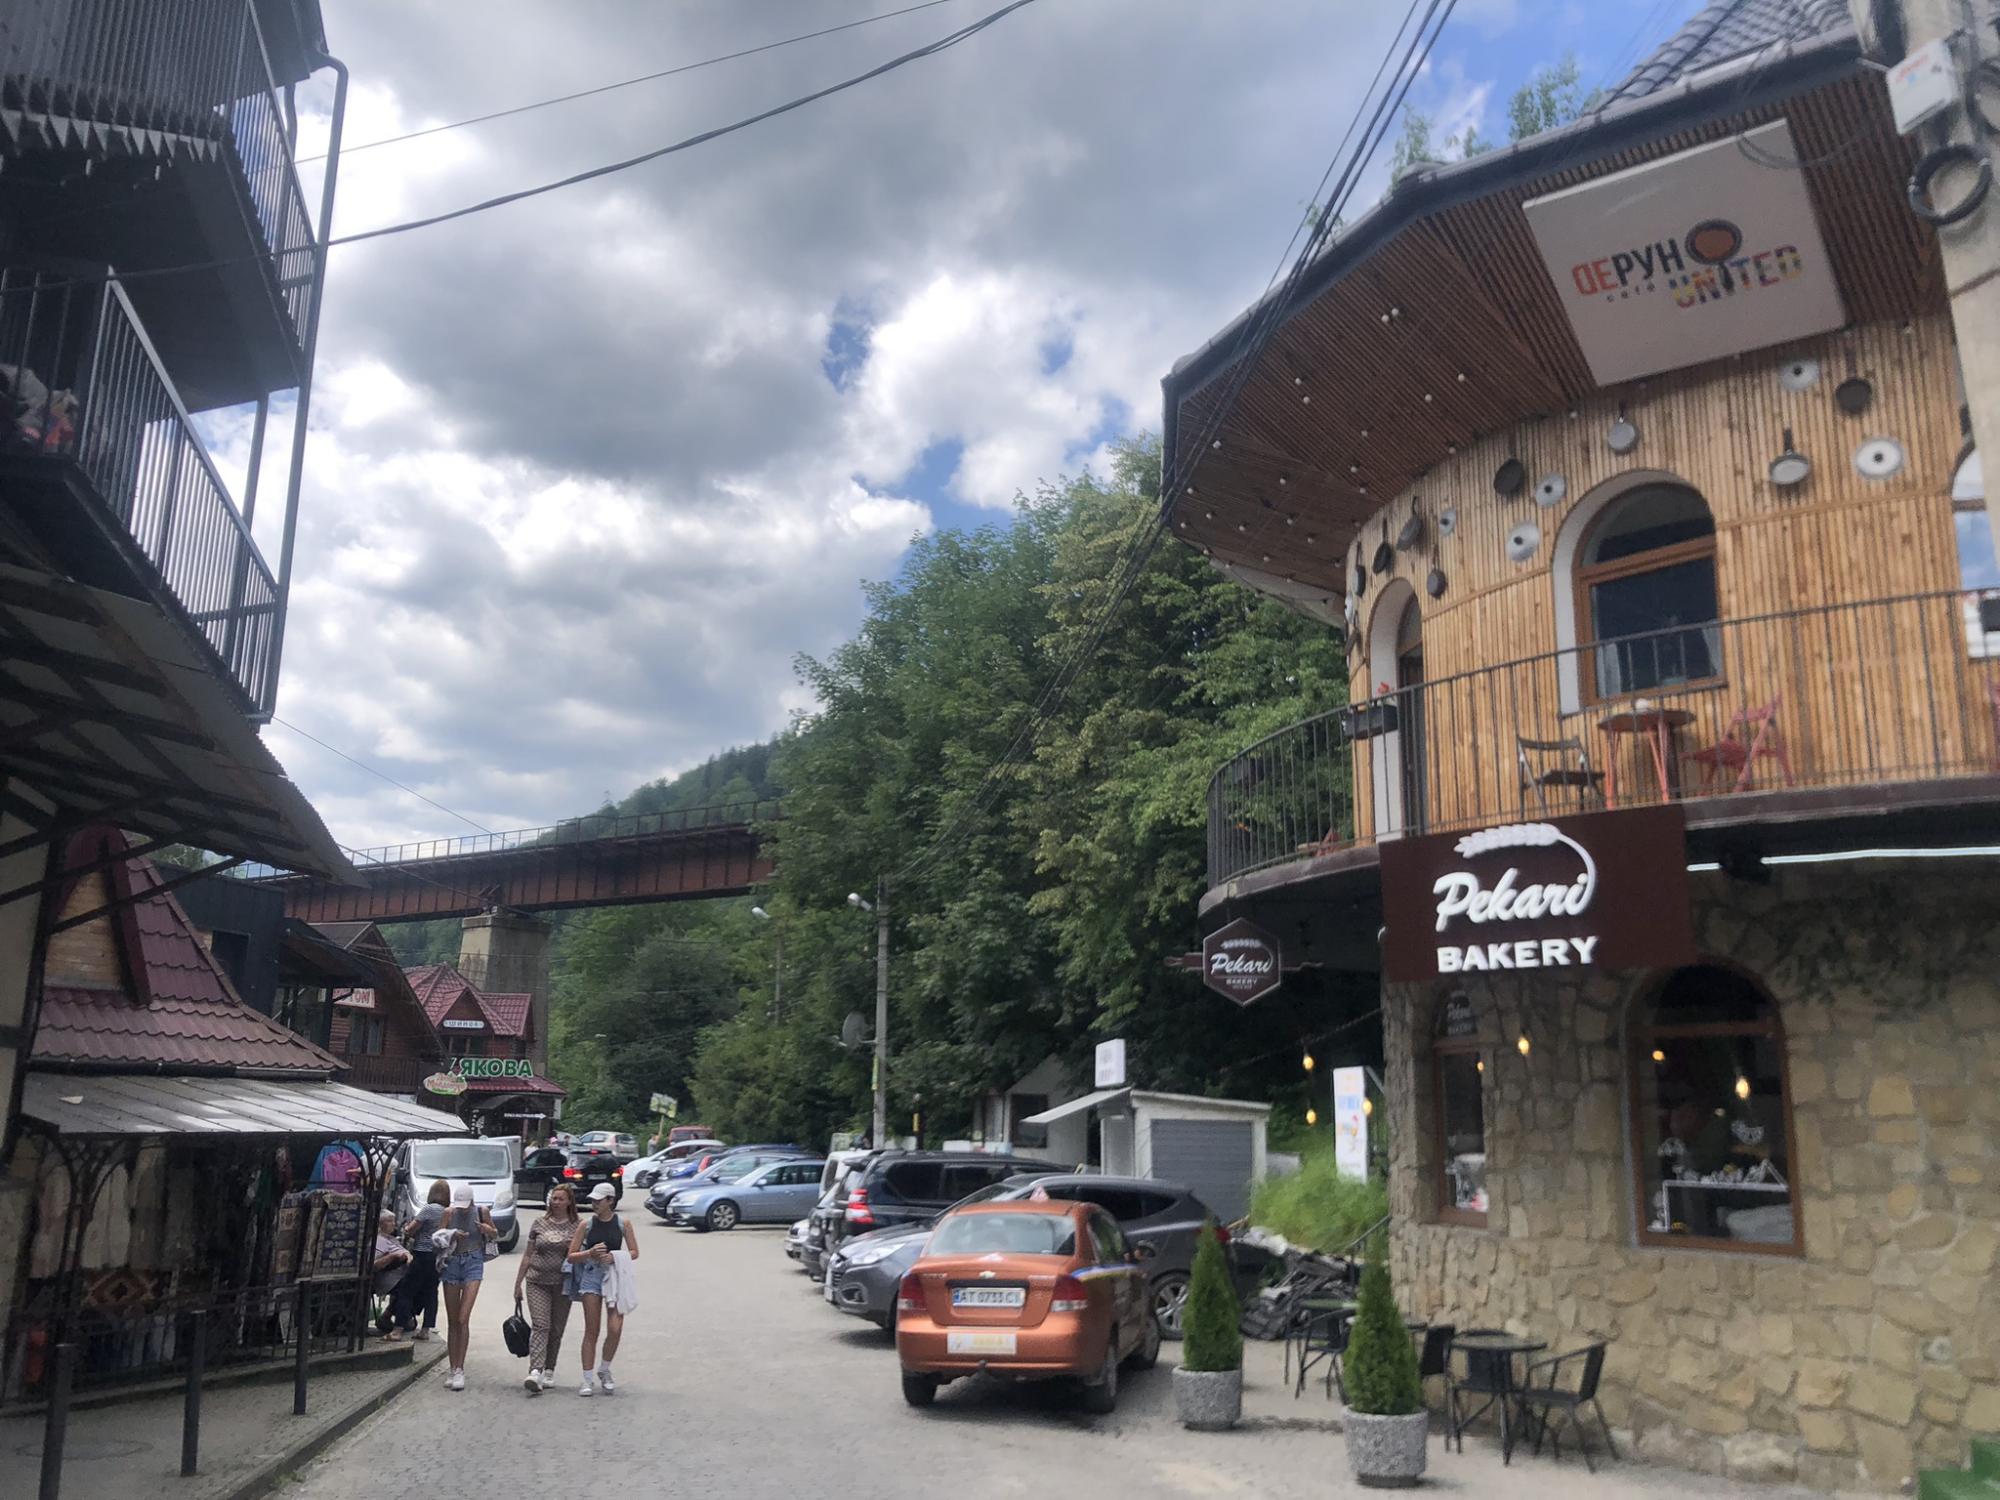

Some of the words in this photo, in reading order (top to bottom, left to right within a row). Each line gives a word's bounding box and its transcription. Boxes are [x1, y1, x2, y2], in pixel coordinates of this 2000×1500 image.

[1432, 867, 1596, 932] Pekari
[1210, 952, 1273, 975] Pekari
[1436, 935, 1600, 973] BAKERY
[459, 1056, 534, 1078] ЯКОВА
